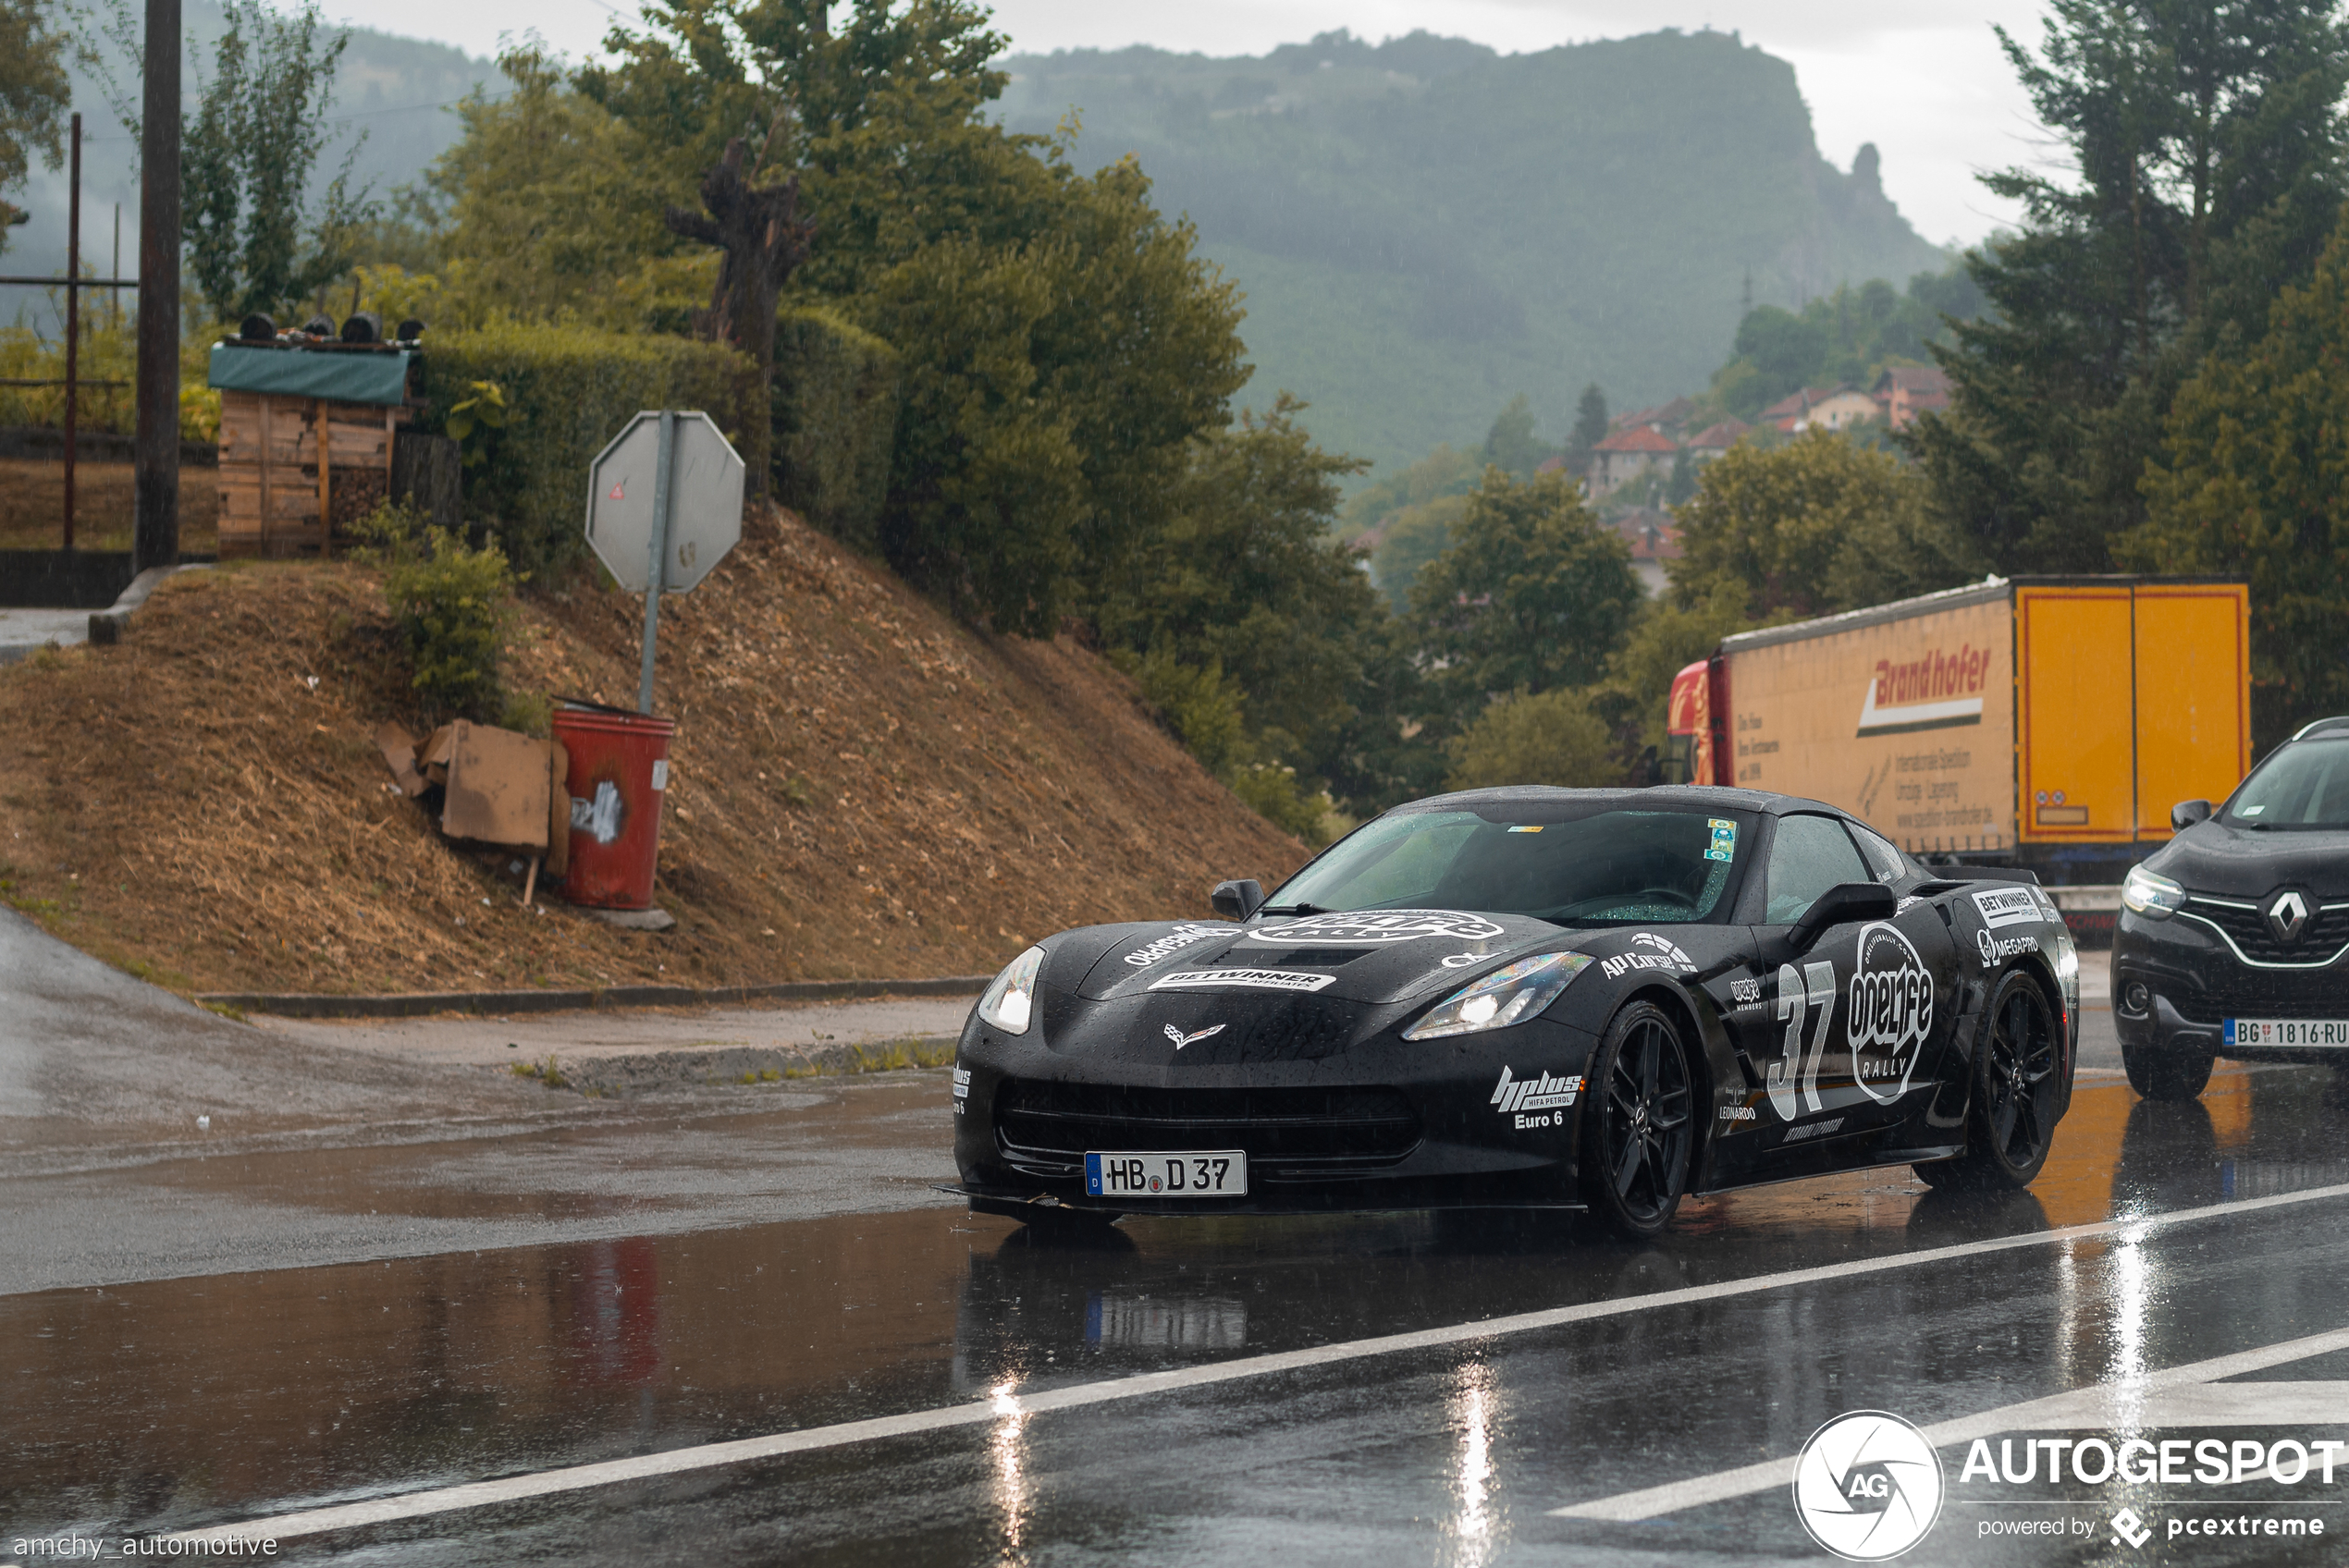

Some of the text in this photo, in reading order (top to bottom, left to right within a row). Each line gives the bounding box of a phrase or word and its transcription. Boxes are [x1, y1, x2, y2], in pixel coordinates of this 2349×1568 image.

[1876, 643, 1990, 705] Brandhofer
[1979, 892, 2033, 913] BETWINNER
[1600, 952, 1675, 980] AP Corse
[1168, 970, 1322, 984] BETWINNER
[1736, 1002, 1763, 1012] MEMBERS
[1767, 960, 1836, 1122] 37
[2238, 1023, 2259, 1043] BG
[1862, 1058, 1907, 1079] RALLY
[1490, 1064, 1582, 1113] hplus
[1529, 1096, 1570, 1107] HIFA PETROL
[1515, 1110, 1563, 1129] Euro 6
[1719, 1106, 1756, 1121] LEONARDO
[1091, 1178, 1098, 1188] D
[1110, 1158, 1230, 1191] HB D 37
